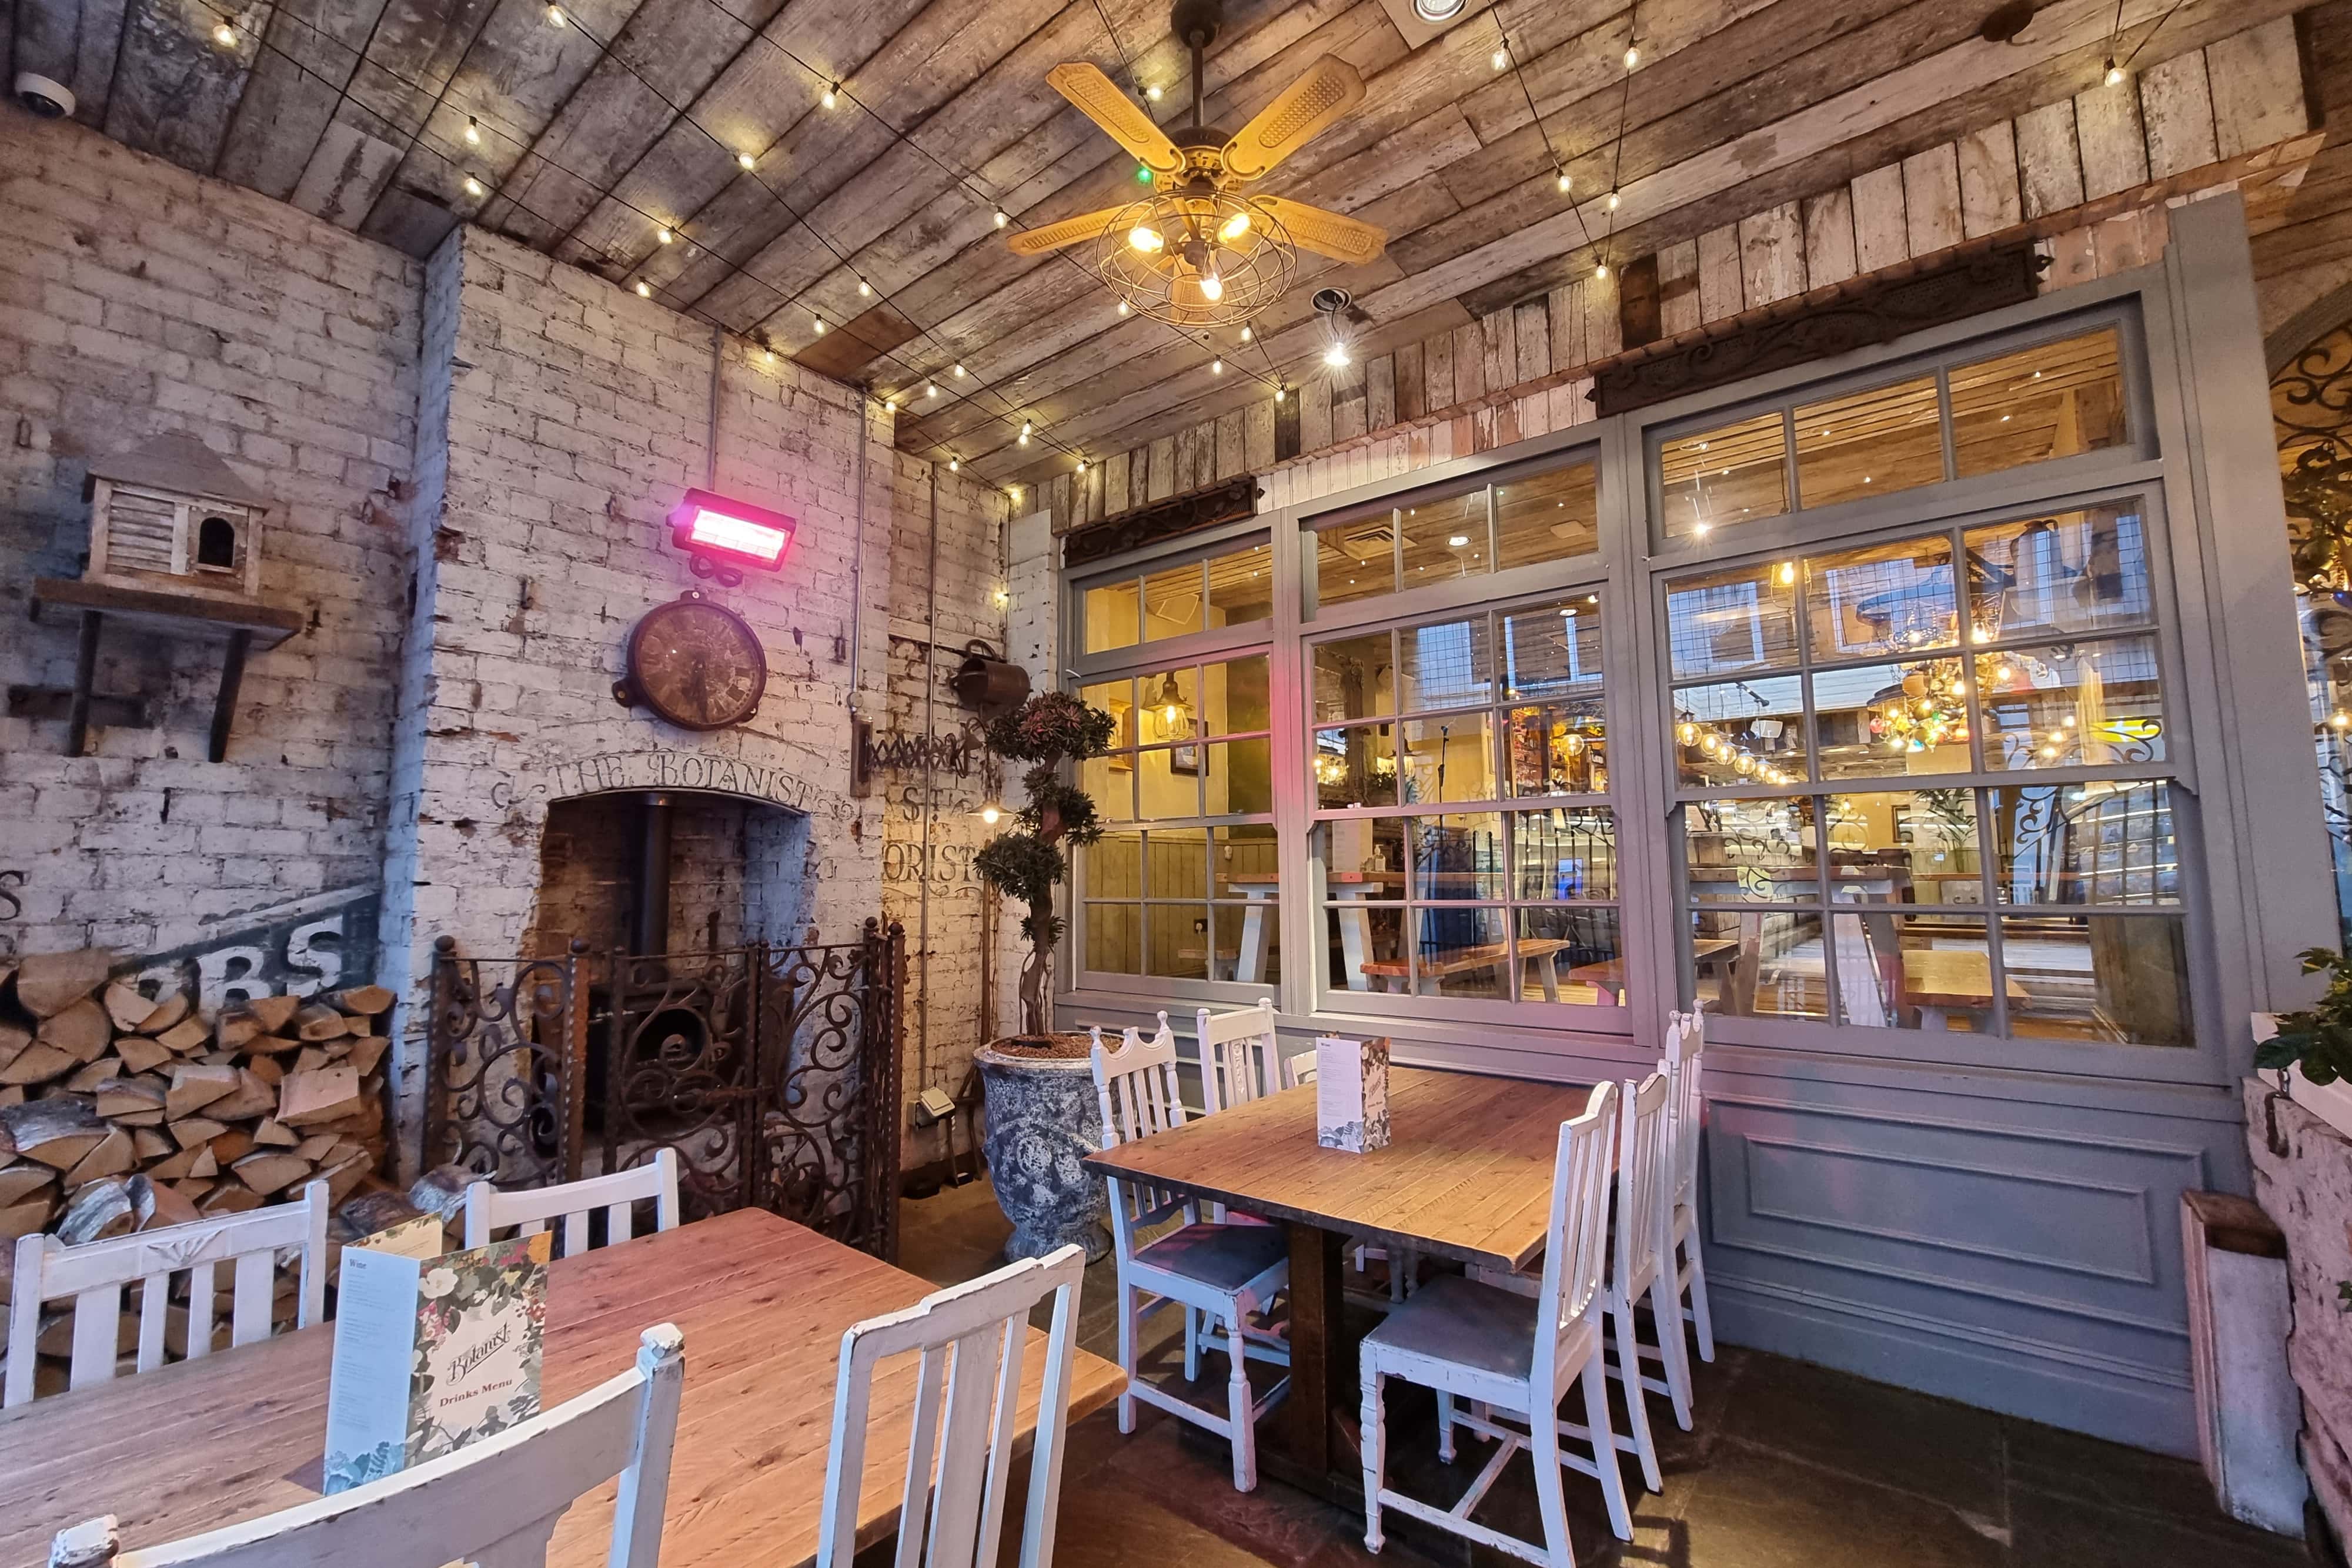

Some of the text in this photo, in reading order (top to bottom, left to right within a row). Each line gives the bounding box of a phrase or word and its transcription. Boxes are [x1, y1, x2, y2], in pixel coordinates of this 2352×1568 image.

[547, 750, 814, 809] THE BOTANIST
[446, 1320, 512, 1386] Botanist
[439, 1379, 513, 1407] Drinks Menu
